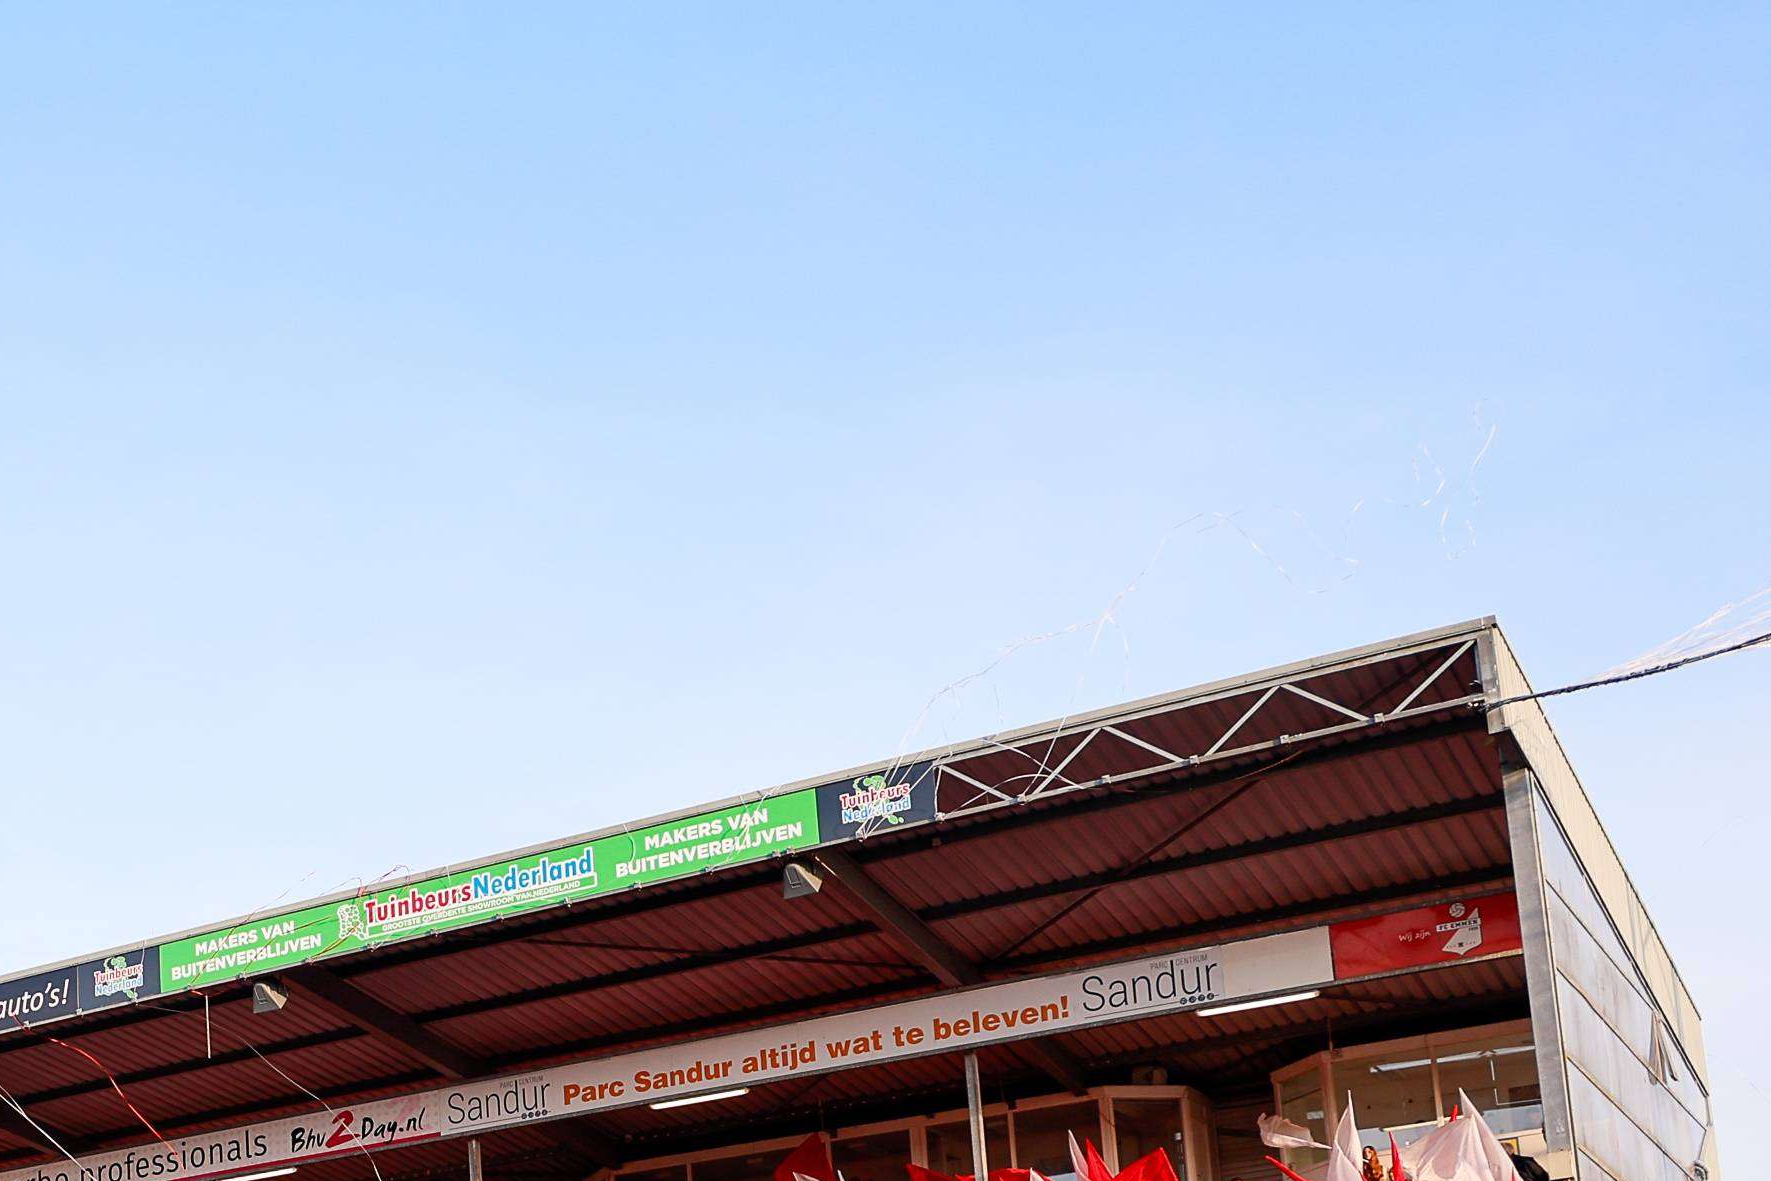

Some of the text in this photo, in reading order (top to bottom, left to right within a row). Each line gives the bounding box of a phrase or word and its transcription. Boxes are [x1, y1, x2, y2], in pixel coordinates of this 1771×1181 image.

[839, 783, 910, 809] Tuinbeurs
[841, 797, 912, 824] Nederland
[616, 822, 803, 879] BUITENVERBLIJVEN
[645, 808, 768, 851] MAKERS VAN
[382, 916, 422, 932] GROOTSTE
[422, 907, 467, 923] OVERDEKTE
[467, 897, 513, 913] SHOWROOM
[532, 880, 582, 899] NEDERLAND
[171, 932, 323, 981] BUITENVERBLIJVEN
[195, 920, 296, 958] MAKERS VAN
[93, 963, 144, 983] Tuinbeurs
[94, 974, 145, 997] Nederland
[1082, 960, 1219, 1013] Sandur
[563, 994, 1071, 1106] Parc Sandur altijd wat te beleven!
[447, 1078, 551, 1125] Sandur
